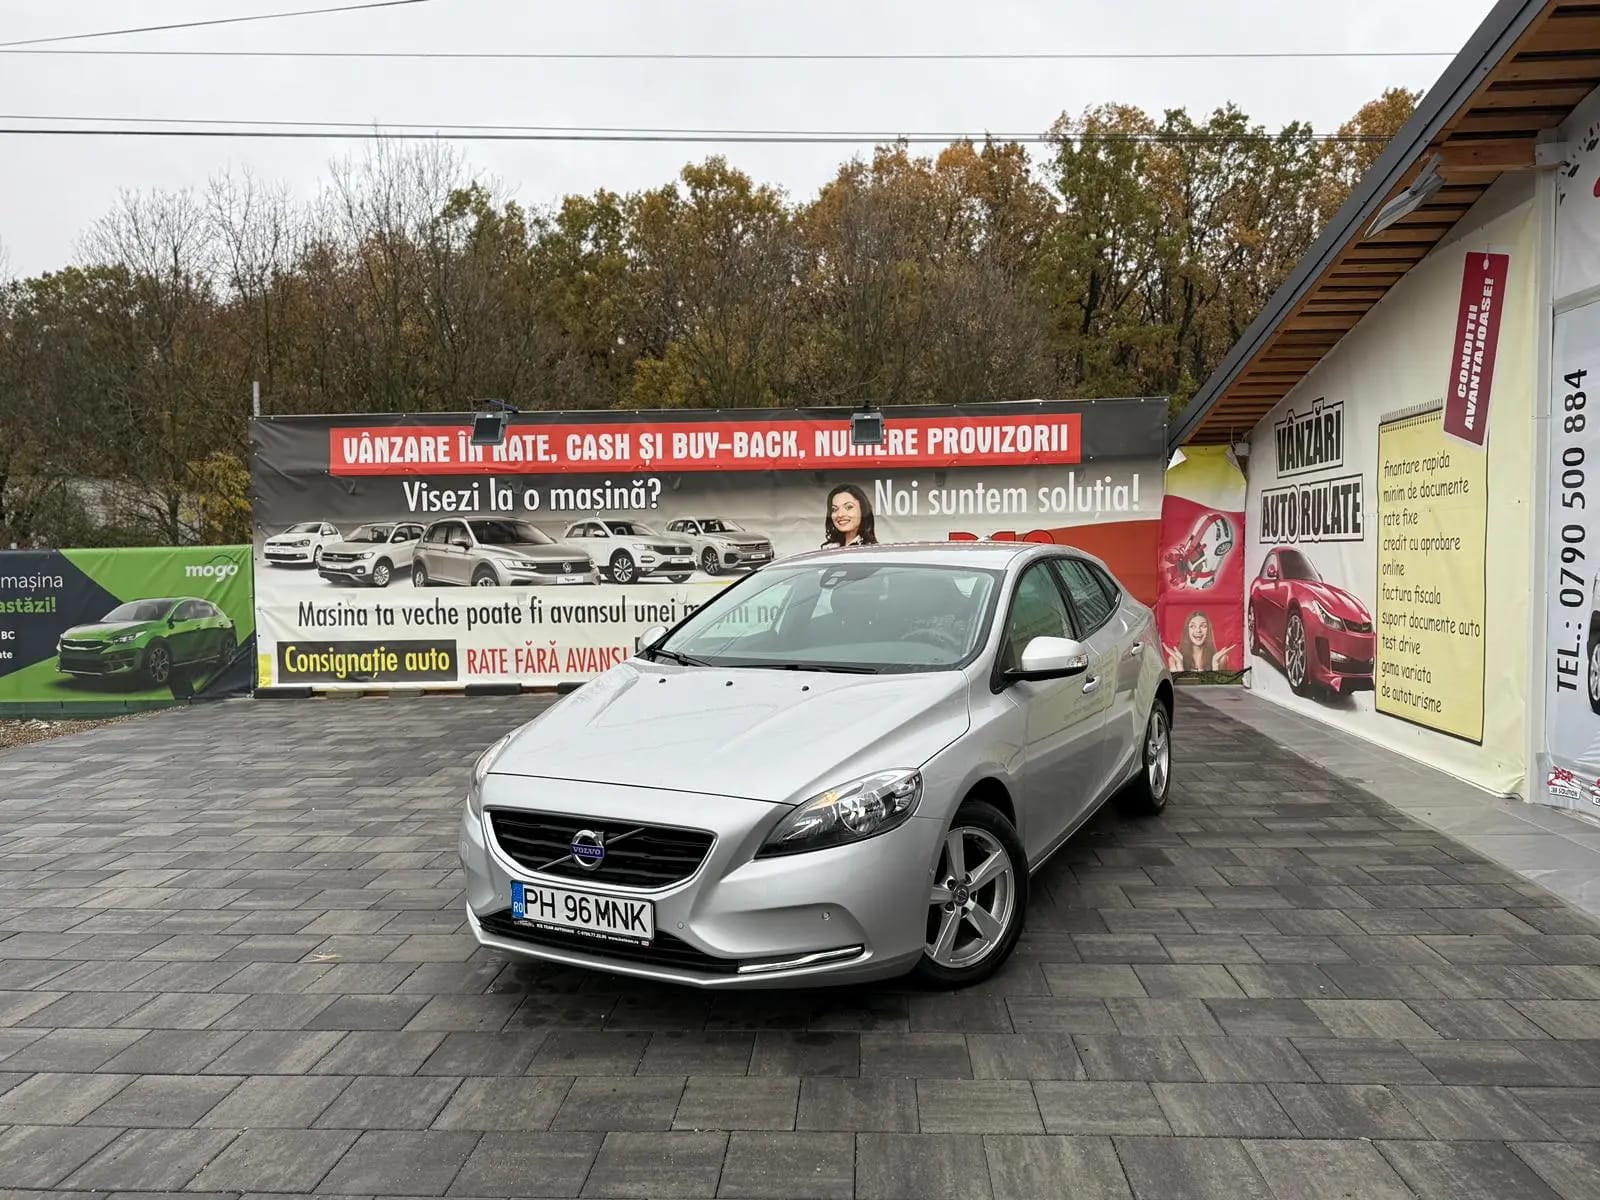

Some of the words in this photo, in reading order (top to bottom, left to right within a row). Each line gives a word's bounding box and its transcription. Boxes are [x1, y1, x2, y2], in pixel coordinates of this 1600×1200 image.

[1458, 305, 1478, 398] CONDITII
[1464, 277, 1494, 431] AVANTAJOASE!
[1564, 369, 1587, 433] 884
[343, 432, 450, 463] VÂNZARE
[566, 433, 630, 461] CASH
[639, 432, 663, 465] ȘI
[927, 423, 1068, 455] PROVIZORII
[1276, 405, 1341, 472] VÂNZĂRI
[1384, 459, 1420, 478] finantare
[1422, 450, 1450, 476] rapida
[1562, 447, 1585, 509] 500
[402, 480, 480, 512] Visezi
[489, 478, 513, 511] la
[523, 489, 540, 511] o
[875, 478, 918, 516] Noi
[928, 482, 1027, 515] suntem
[1038, 471, 1139, 519] soluția!
[1383, 484, 1405, 502] minim
[1407, 481, 1418, 500] de
[1420, 477, 1469, 498] documente
[1262, 492, 1298, 537] AUTO
[1301, 482, 1361, 536] RULATE
[1383, 511, 1400, 526] rate
[1402, 508, 1418, 527] fixe
[1383, 534, 1407, 551] credit
[1409, 538, 1419, 551] cu
[1420, 532, 1461, 556] aprobare
[0, 572, 63, 592] mașina
[185, 565, 239, 582] mogo
[1382, 559, 1405, 576] online
[1559, 524, 1586, 607] 0790
[1382, 583, 1412, 602] factura
[1414, 585, 1441, 605] fiscala
[299, 601, 367, 627] Masina
[375, 604, 394, 625] ta
[402, 597, 459, 625] veche
[467, 602, 522, 631] poate
[529, 596, 543, 624] fi
[551, 595, 626, 624] avansul
[634, 598, 676, 623] unei
[1382, 611, 1407, 630] suport
[1409, 611, 1456, 634] documente
[1459, 620, 1481, 637] auto
[467, 648, 509, 675] RATE
[515, 640, 560, 674] FĂRĂ
[1382, 634, 1396, 651] test
[1399, 635, 1421, 654] drive
[285, 646, 398, 679] Consignație
[405, 648, 450, 671] auto
[1381, 661, 1400, 678] gama
[1401, 663, 1432, 684] variata
[1381, 680, 1391, 698] de
[1392, 687, 1442, 713] autoturisme
[572, 846, 601, 855] VOLVO
[513, 901, 524, 913] RO
[524, 887, 556, 919] PH
[565, 894, 592, 924] 96
[595, 898, 648, 932] MNK
